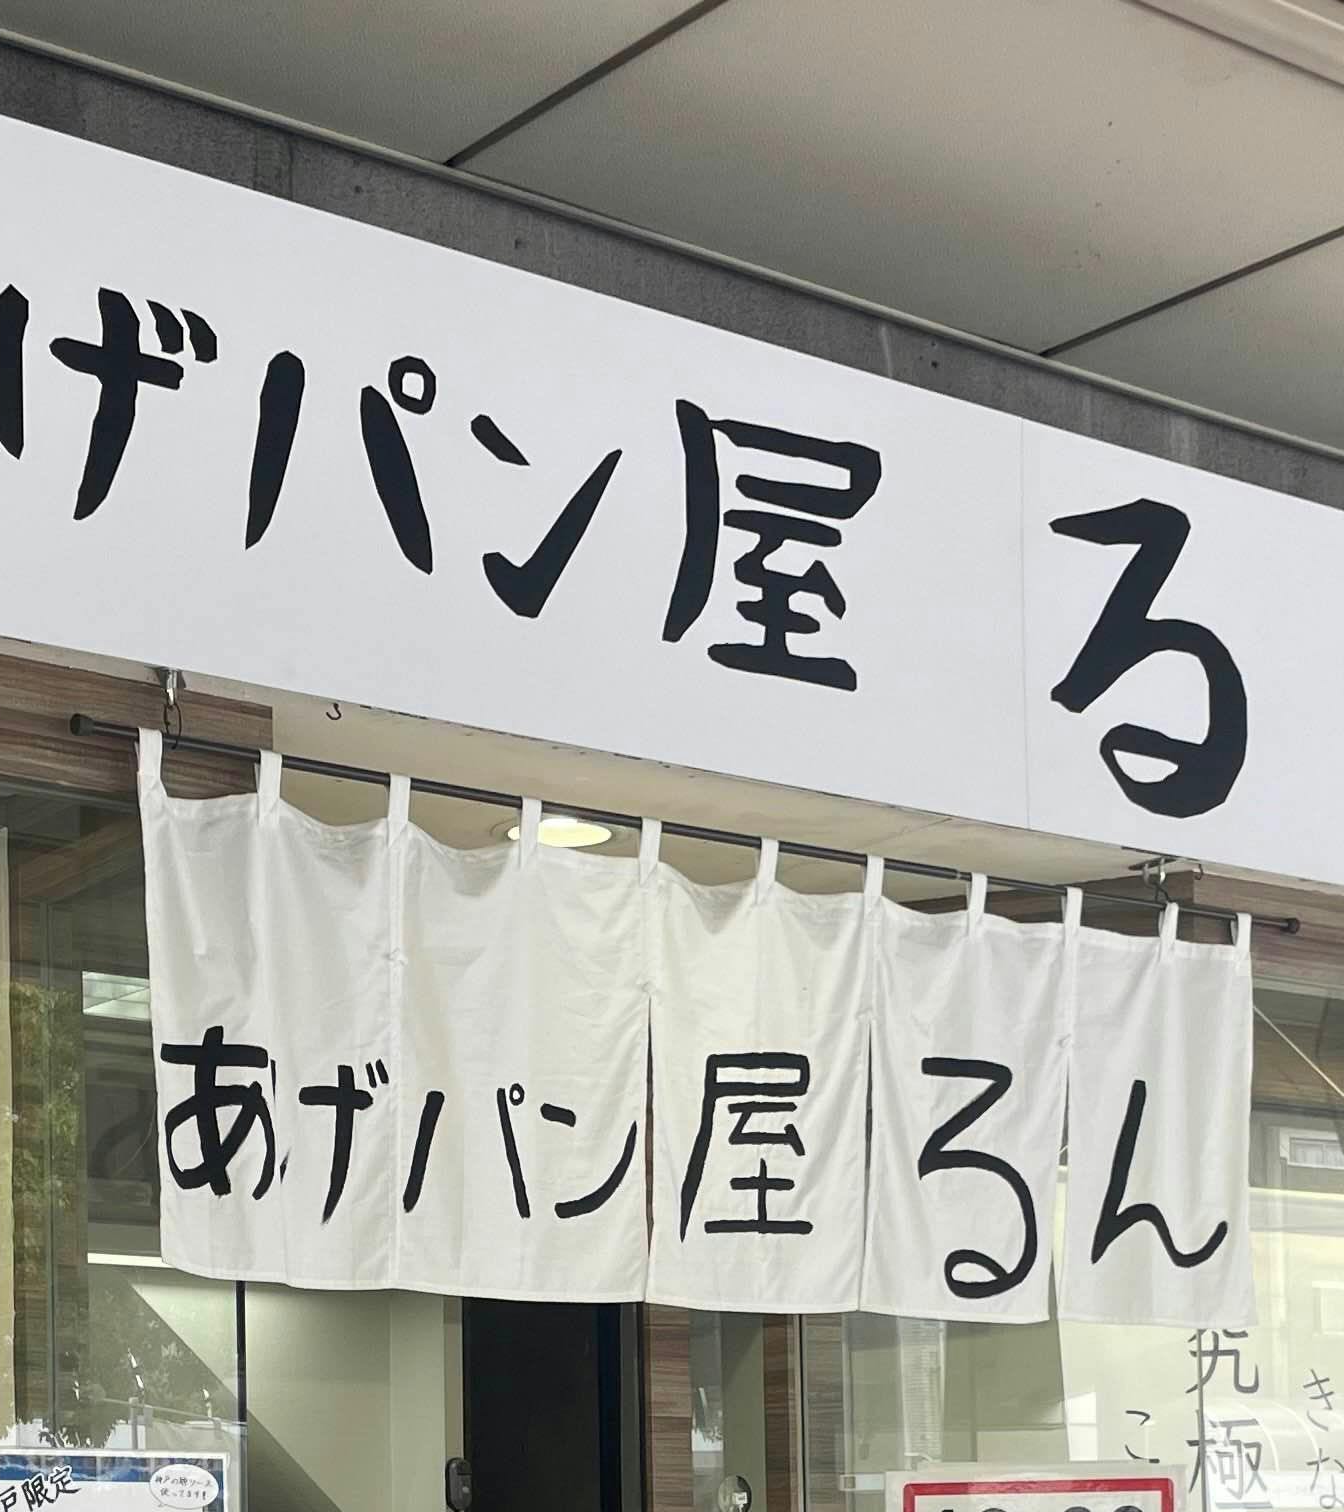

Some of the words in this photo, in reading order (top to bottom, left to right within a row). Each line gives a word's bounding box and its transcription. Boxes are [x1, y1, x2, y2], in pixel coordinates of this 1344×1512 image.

[159, 1024, 813, 1243] あげパン屋
[917, 1055, 1229, 1299] るん
